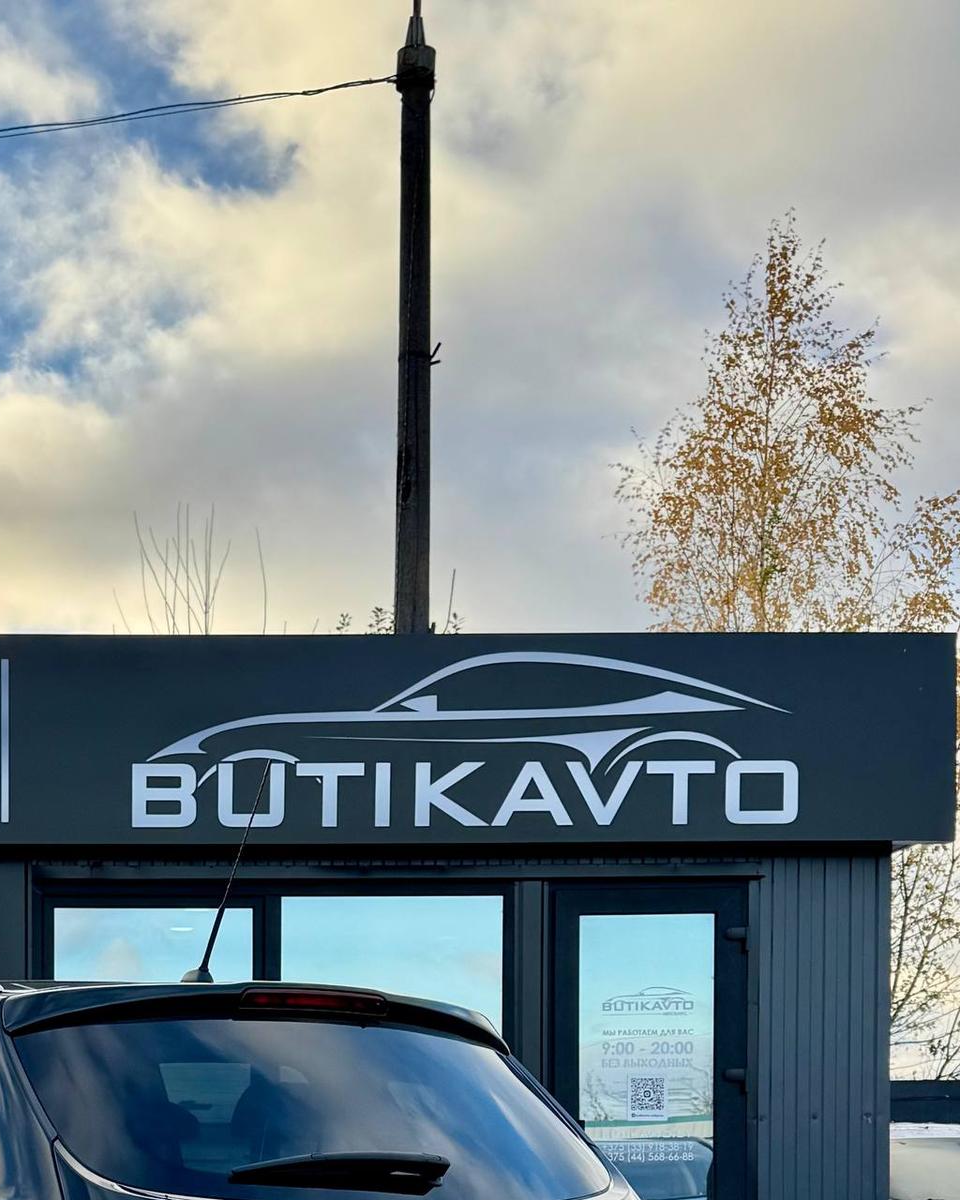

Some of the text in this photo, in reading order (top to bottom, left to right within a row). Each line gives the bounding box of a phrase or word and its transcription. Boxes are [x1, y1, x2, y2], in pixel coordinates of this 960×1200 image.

[131, 758, 799, 828] BUTIKAVTO
[602, 1000, 694, 1011] BUTIKAVTO
[659, 1029, 675, 1037] ДЛЯ
[602, 1041, 634, 1055] 9:00
[650, 1041, 694, 1055] 20:00
[602, 1058, 693, 1069] БЕЗ ВЫХОДНЫХ
[607, 1152, 694, 1162] 375 (44) 568-66-88
